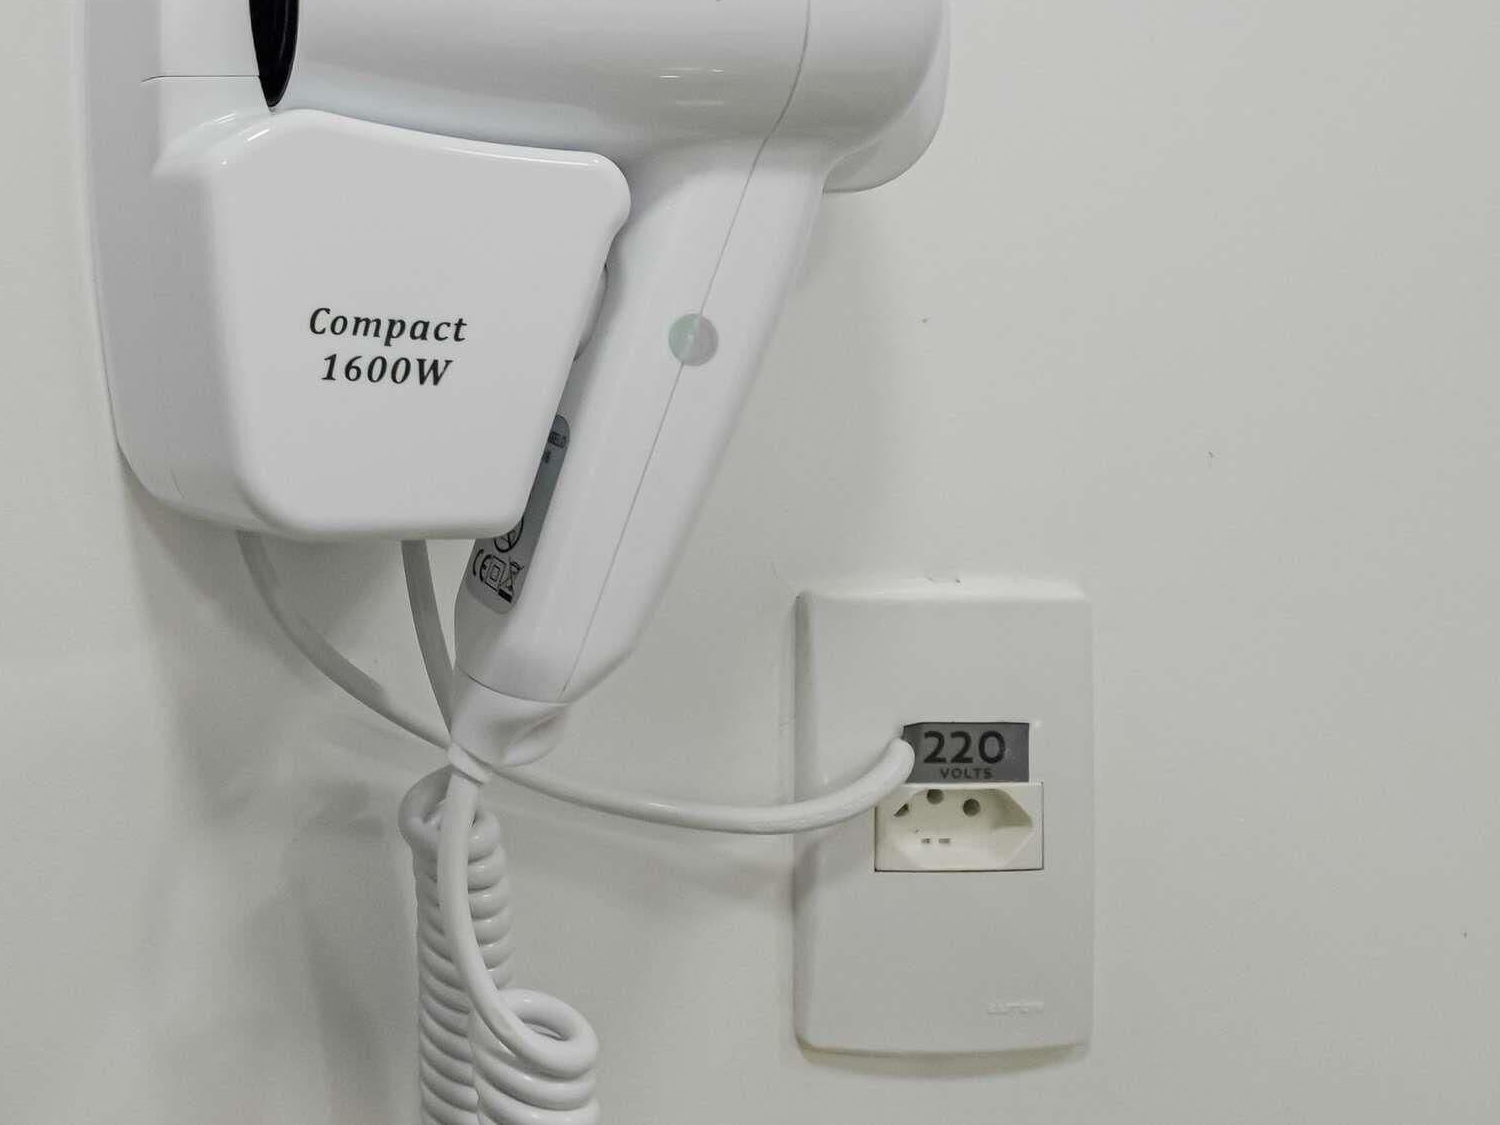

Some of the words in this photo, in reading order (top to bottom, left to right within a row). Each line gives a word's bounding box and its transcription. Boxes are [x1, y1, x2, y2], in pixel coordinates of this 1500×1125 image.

[309, 307, 468, 348] Compact
[321, 353, 454, 387] 1600W
[923, 730, 1006, 764] 220
[939, 767, 994, 780] VOLTS
